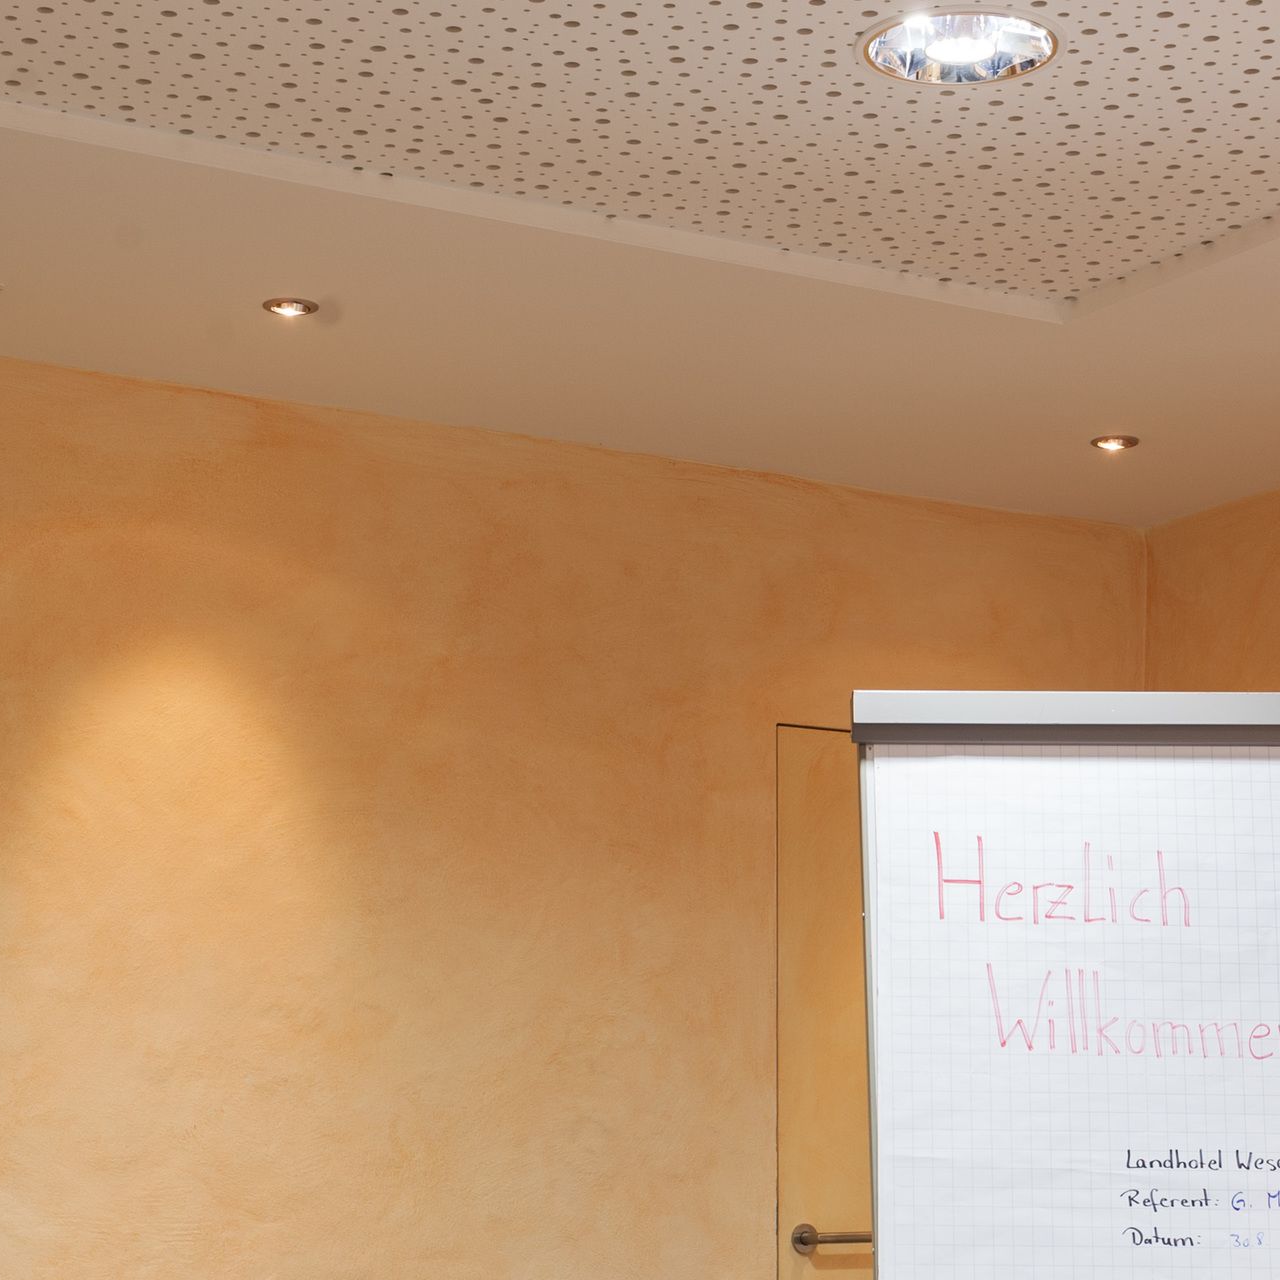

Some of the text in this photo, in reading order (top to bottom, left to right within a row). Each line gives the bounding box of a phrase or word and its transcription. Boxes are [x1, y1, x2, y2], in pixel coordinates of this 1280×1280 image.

[933, 831, 1191, 926] Herzlich
[1126, 1149, 1223, 1171] Landhotel
[1120, 1188, 1220, 1212] Referent:
[1122, 1227, 1202, 1247] Datum:
